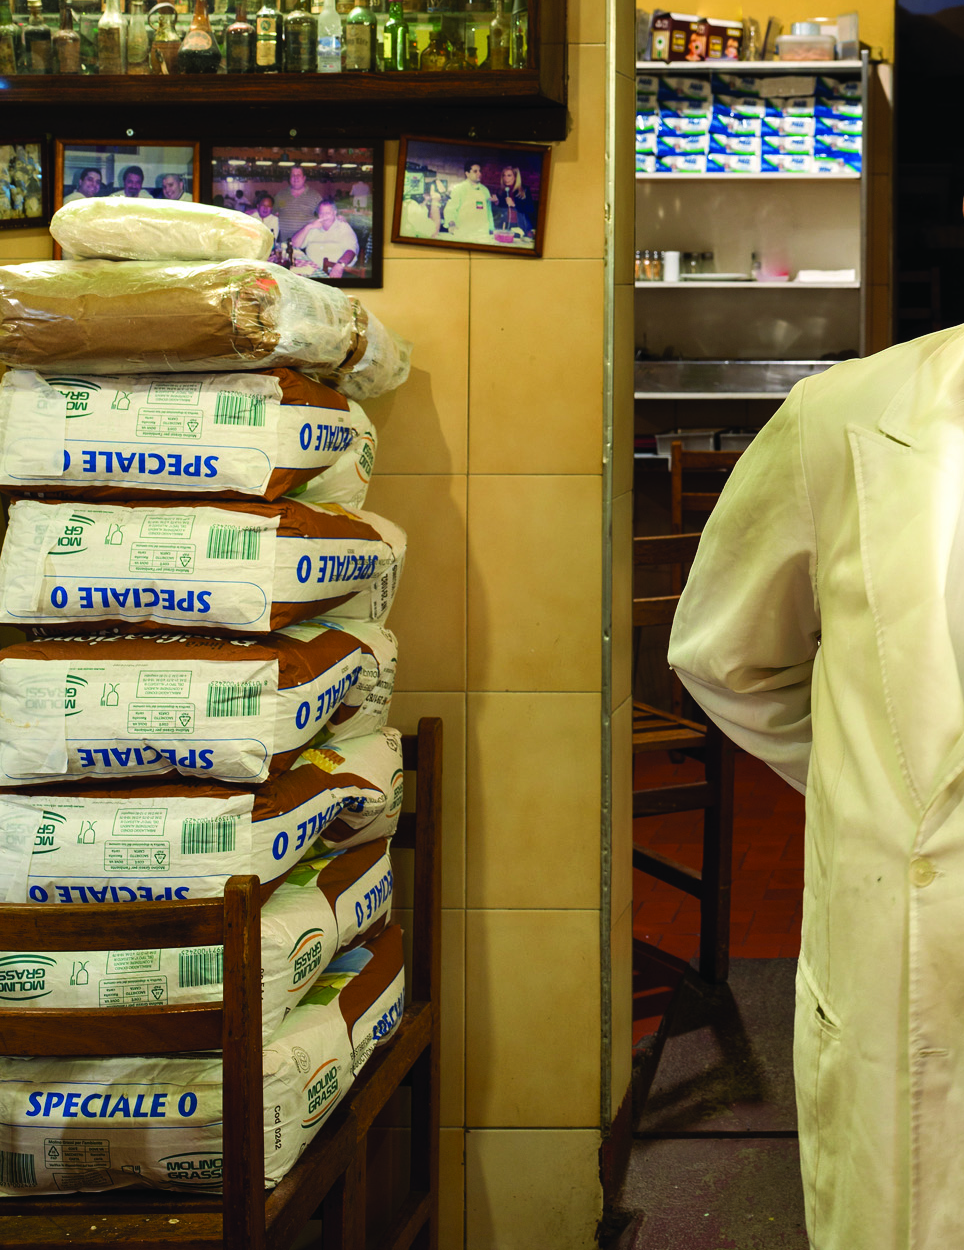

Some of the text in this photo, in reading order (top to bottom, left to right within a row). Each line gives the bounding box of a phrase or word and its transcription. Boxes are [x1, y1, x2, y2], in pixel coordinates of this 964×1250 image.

[299, 422, 313, 451] 0
[82, 450, 220, 478] SPECIALE
[296, 554, 312, 584] 0
[50, 585, 213, 613] SPECIALE 0
[295, 700, 311, 730] 0
[77, 745, 214, 770] SPECIALE
[272, 831, 289, 861] 0
[293, 954, 322, 985] MOLINO
[294, 941, 323, 972] GRASSI
[307, 1065, 338, 1102] MOLINO
[308, 1079, 339, 1115] GRASSI
[25, 1091, 198, 1118] SPECIALE 0
[274, 1105, 283, 1151] Cod 0242
[167, 1169, 223, 1180] GRASS
